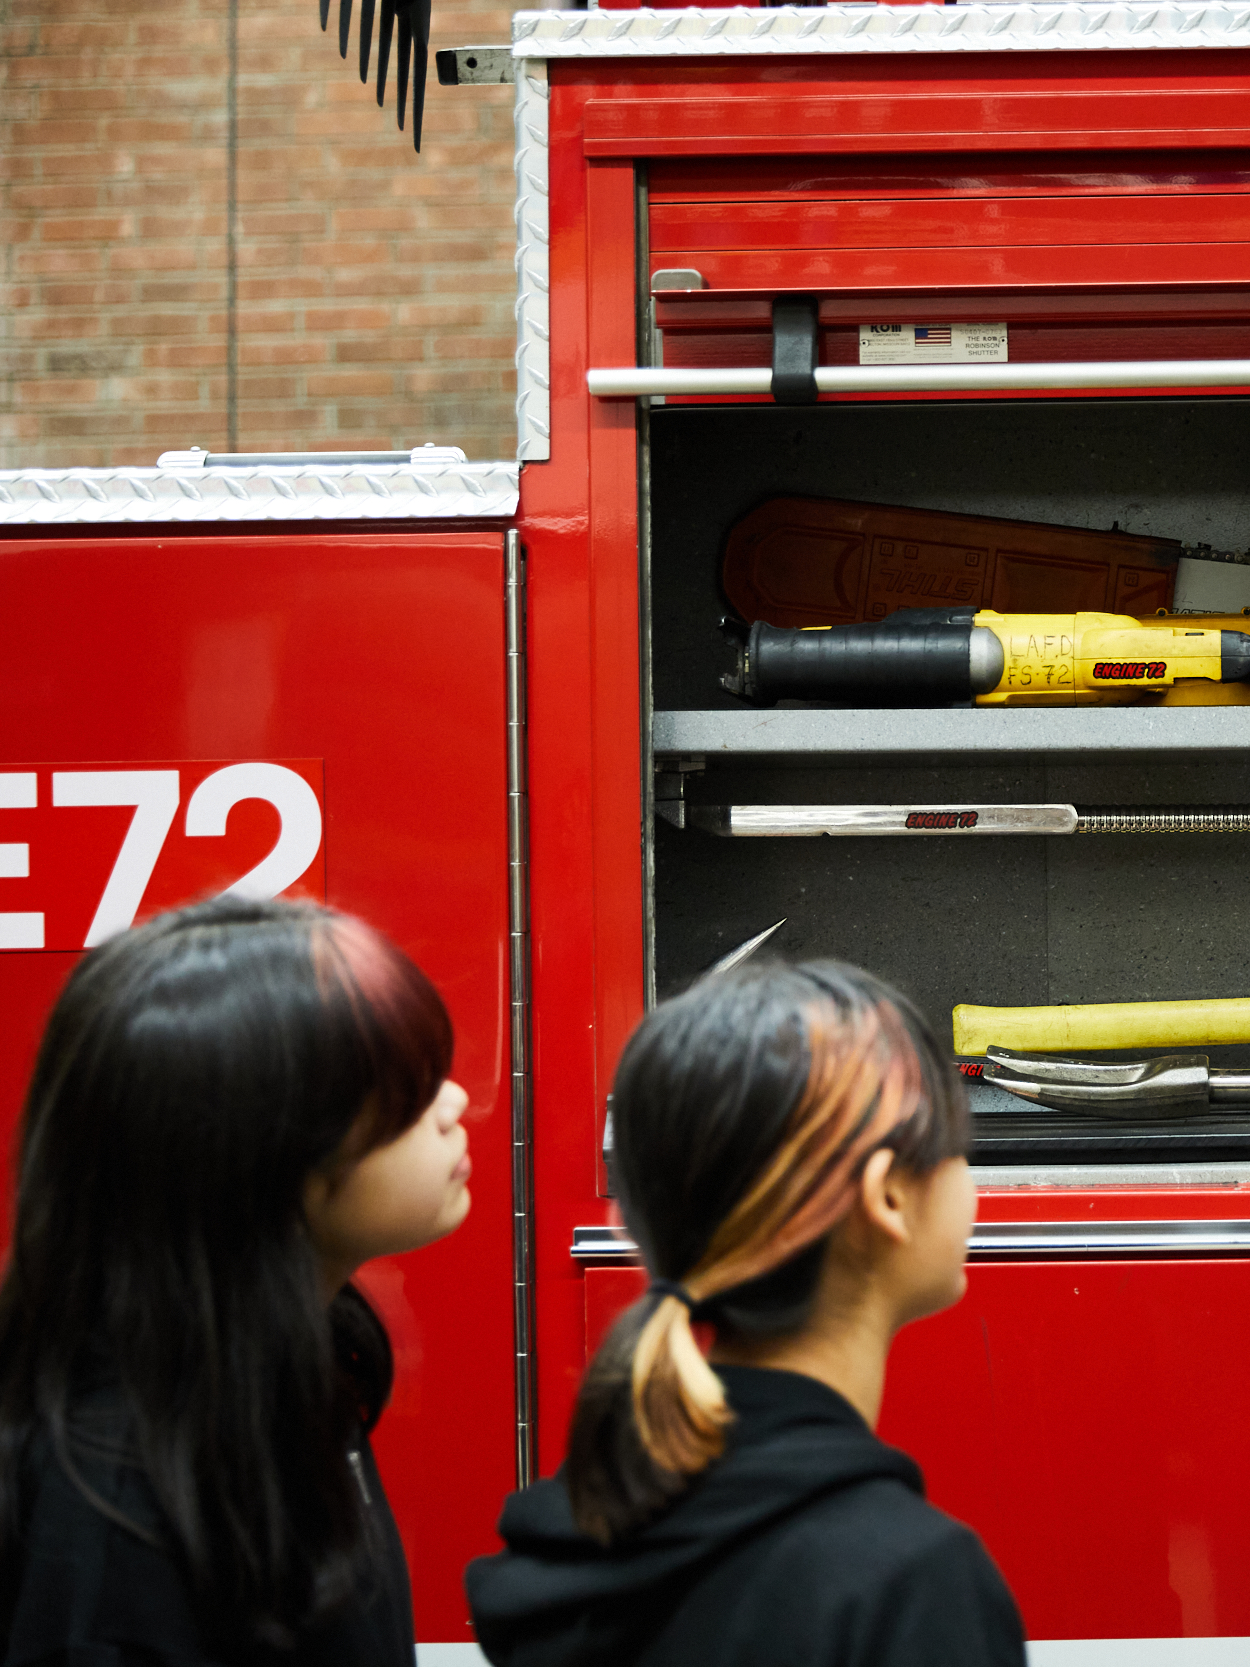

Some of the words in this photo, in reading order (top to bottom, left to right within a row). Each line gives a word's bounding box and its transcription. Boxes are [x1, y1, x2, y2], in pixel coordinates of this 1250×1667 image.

[879, 568, 980, 601] STIHL
[1093, 662, 1145, 679] ENGINE
[1146, 662, 1166, 679] 72
[906, 812, 959, 828] ENGINE
[959, 811, 978, 828] 72
